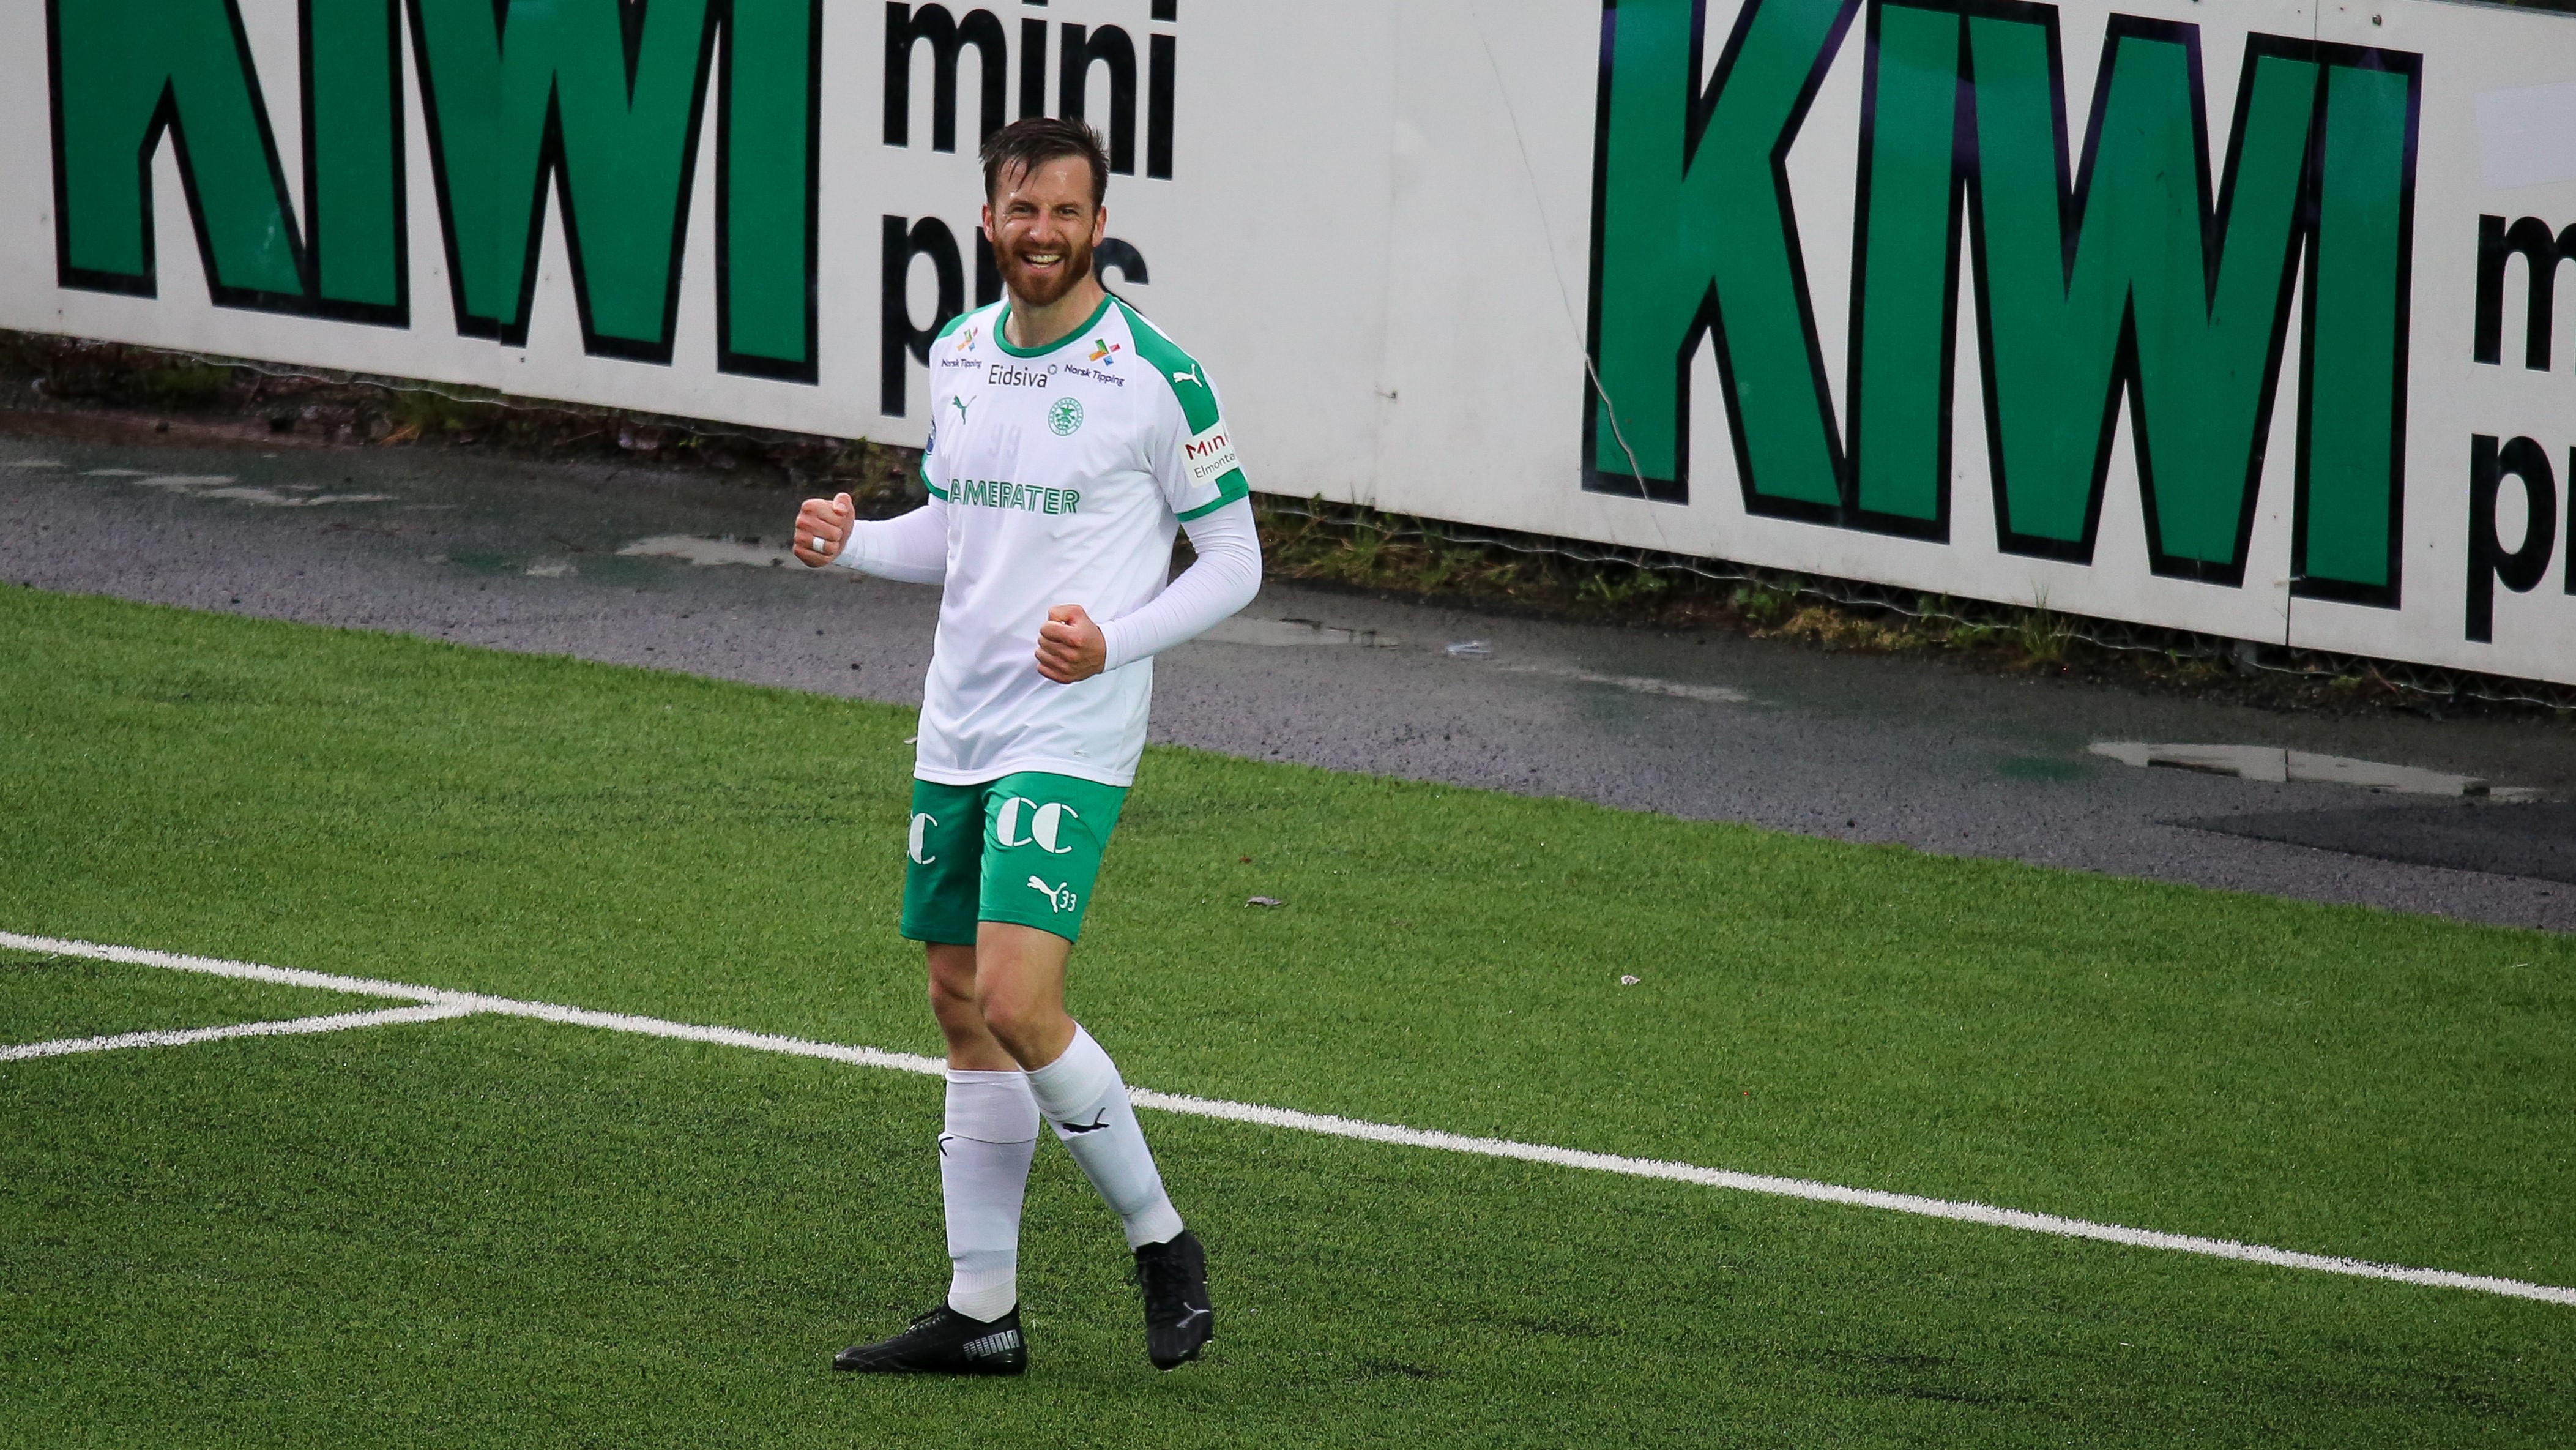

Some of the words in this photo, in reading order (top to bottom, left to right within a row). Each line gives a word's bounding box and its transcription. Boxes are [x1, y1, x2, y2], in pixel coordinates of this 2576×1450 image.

[883, 0, 1177, 181] mini
[46, 0, 823, 386] KIWI
[1581, 0, 2423, 610] KIWI
[942, 358, 959, 367] Norsk
[988, 364, 1048, 388] Eidsiva
[1065, 364, 1090, 378] Norsk
[1093, 370, 1125, 387] Tipping
[1185, 432, 1229, 460] Min
[1194, 453, 1235, 478] Elmonta
[948, 479, 1080, 515] AMERATER
[1060, 891, 1078, 912] 33
[962, 1329, 1020, 1361] PUMA
